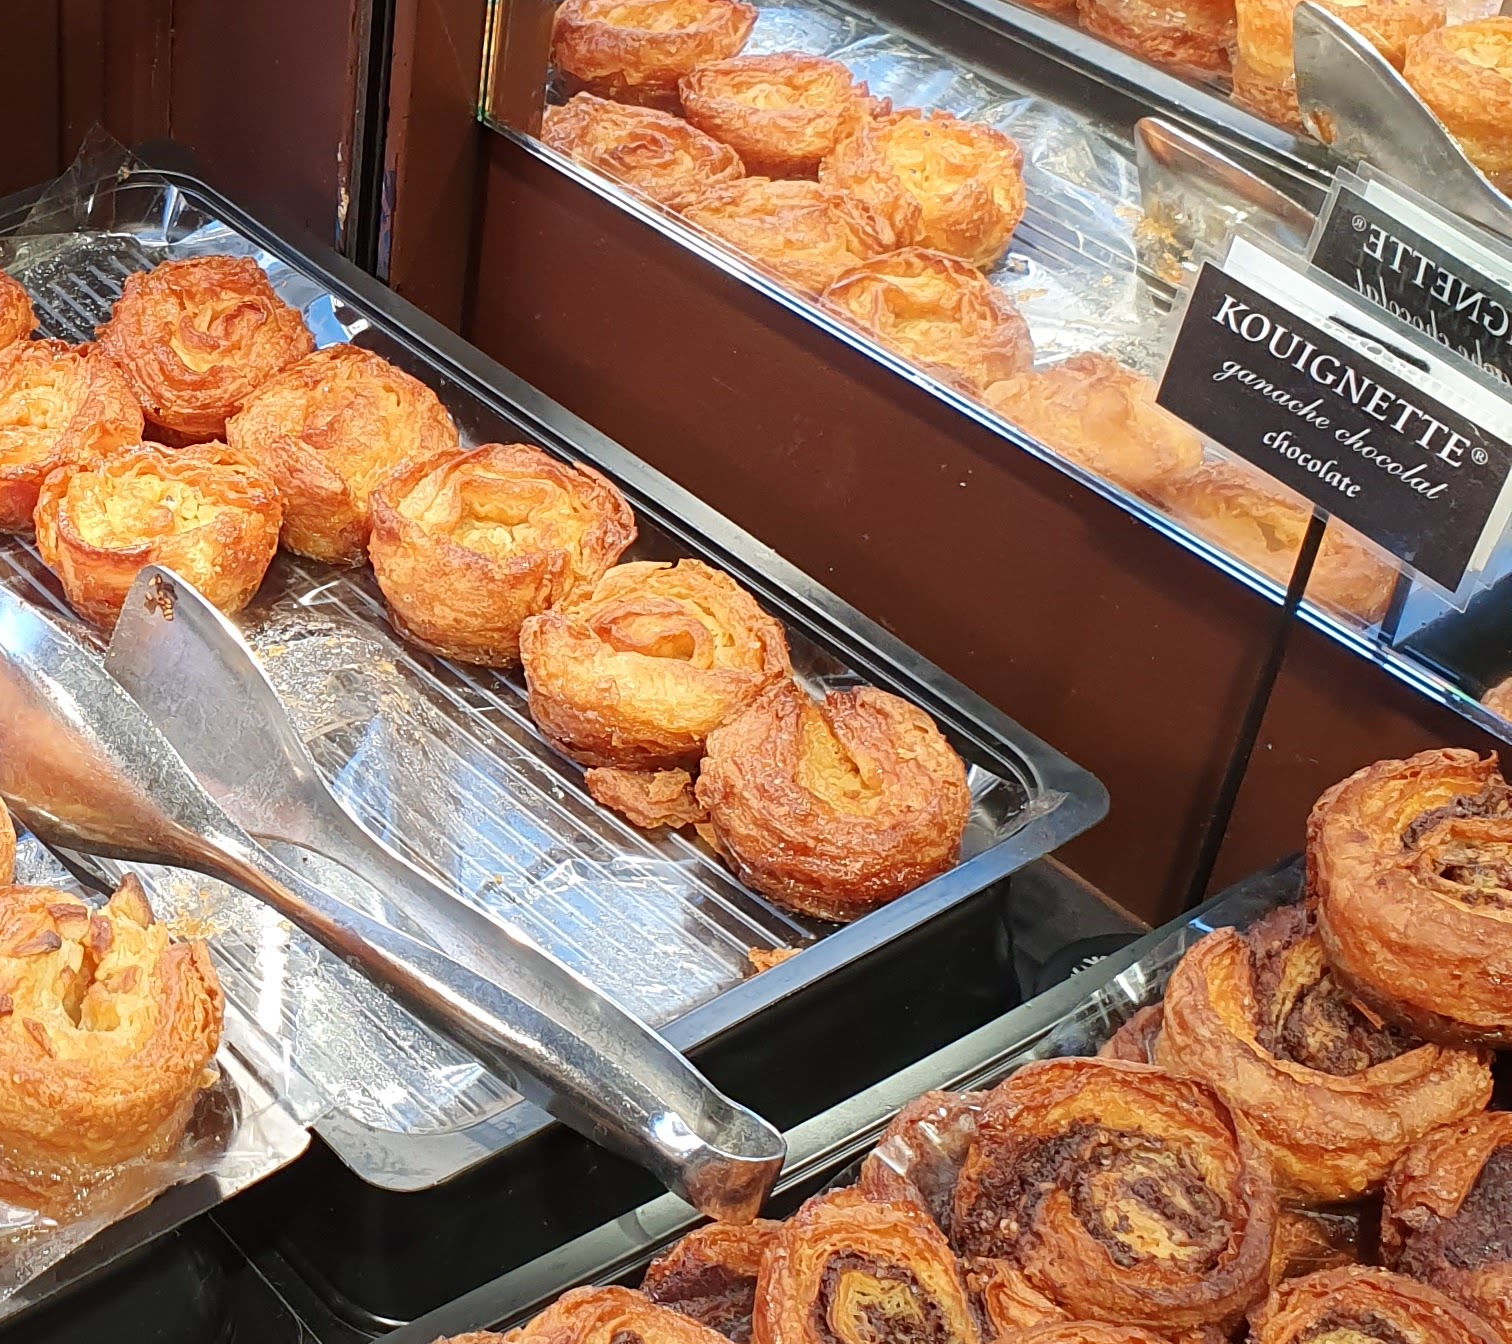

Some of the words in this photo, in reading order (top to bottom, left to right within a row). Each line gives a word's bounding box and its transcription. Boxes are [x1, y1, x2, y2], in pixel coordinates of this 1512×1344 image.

[1211, 356, 1331, 430] ganache
[1334, 426, 1450, 501] chocolat
[1261, 426, 1363, 499] chocolate
